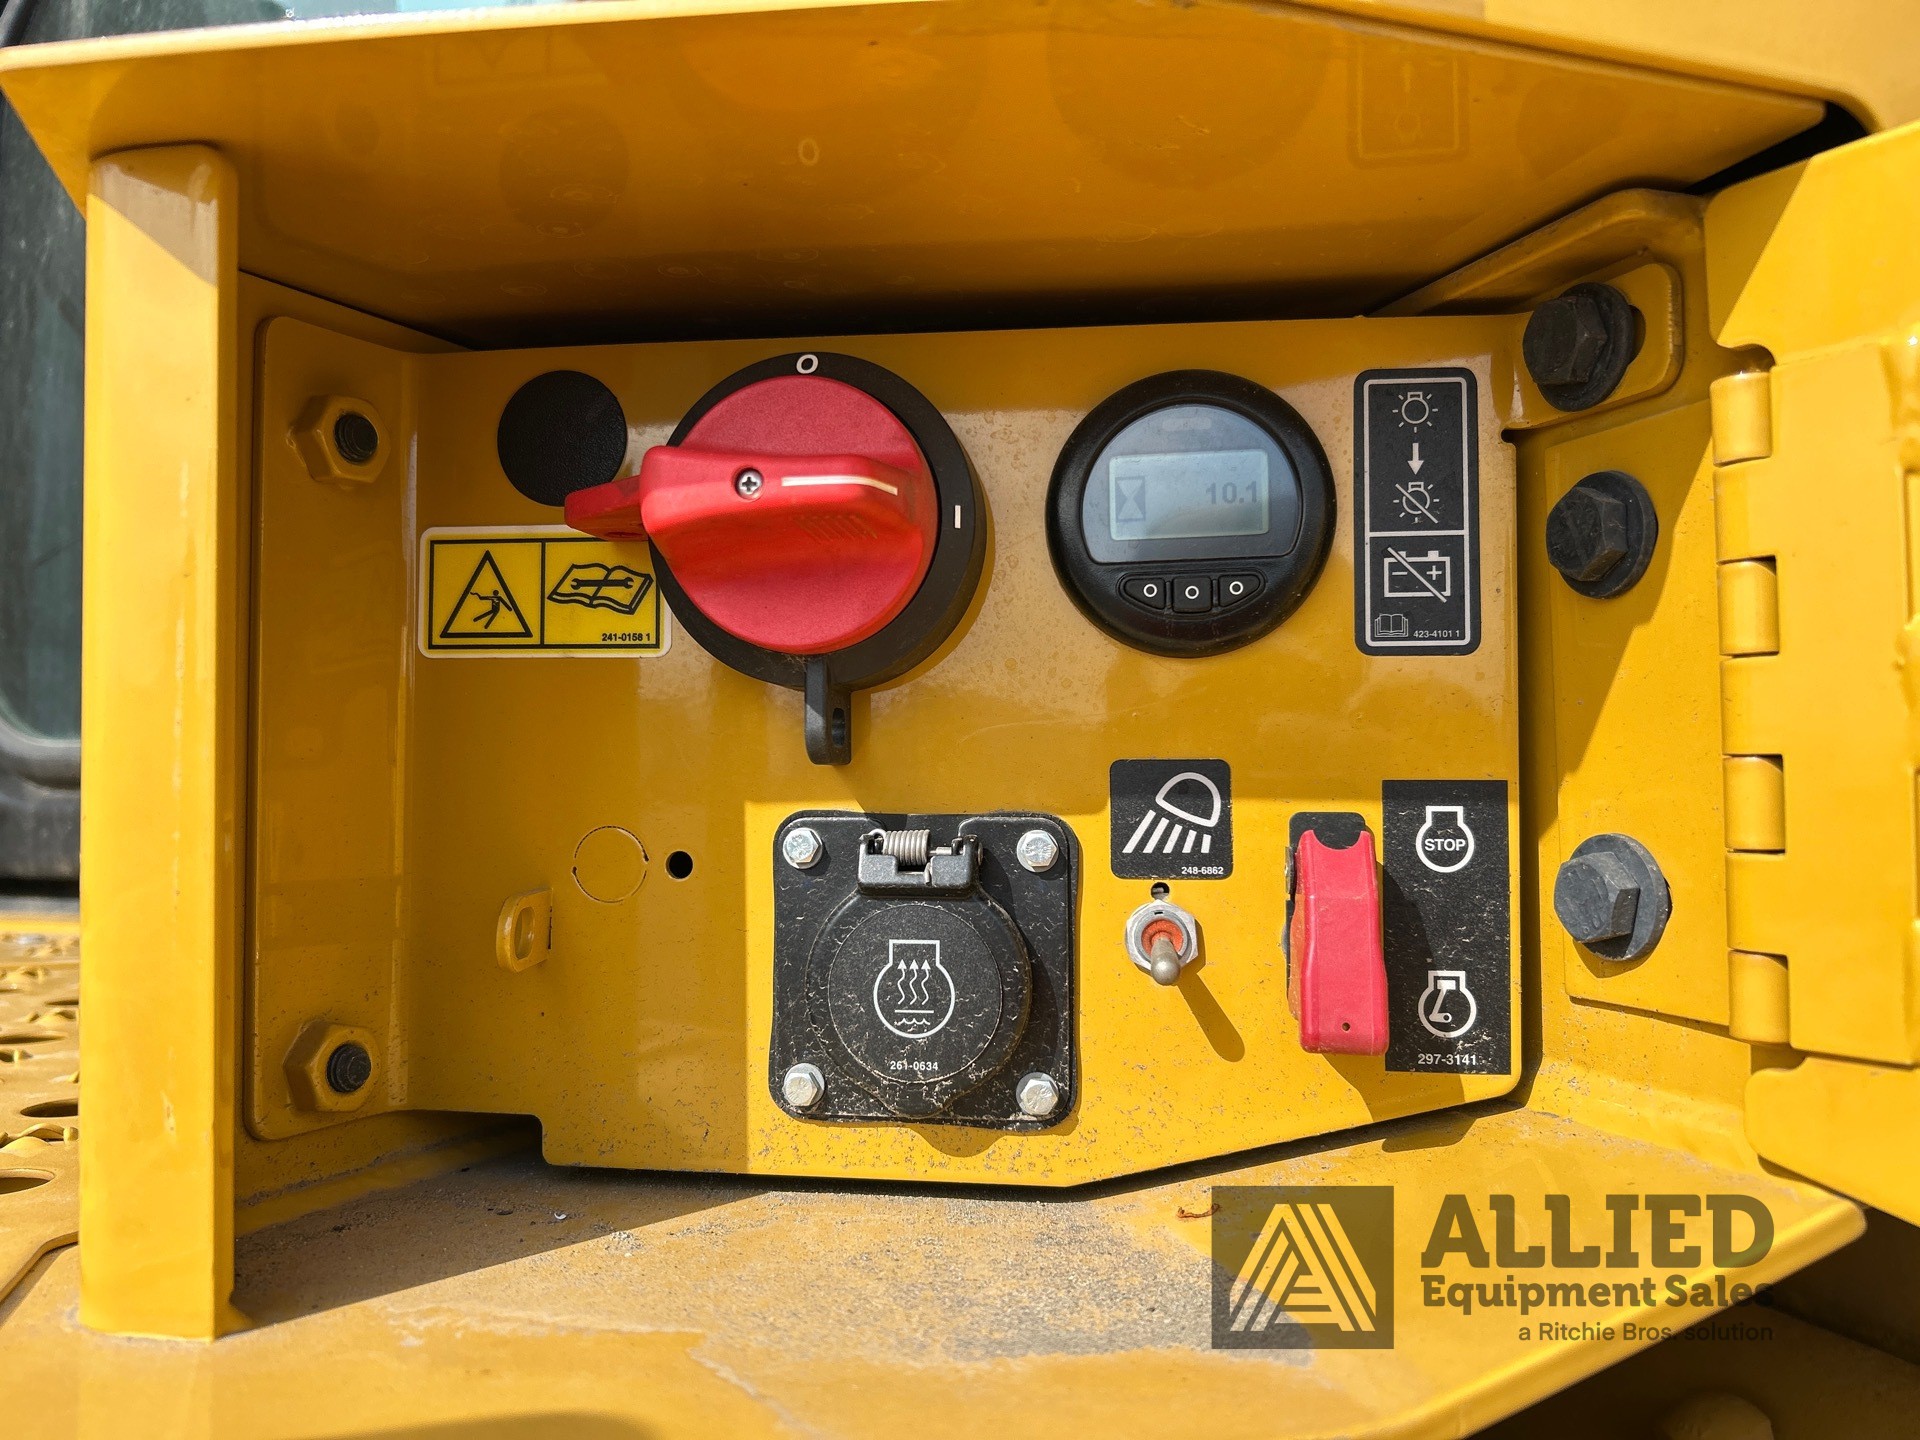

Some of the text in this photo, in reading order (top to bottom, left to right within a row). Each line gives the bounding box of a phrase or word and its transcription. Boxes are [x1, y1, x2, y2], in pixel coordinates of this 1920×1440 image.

[1205, 480, 1258, 505] 10.1
[1413, 630, 1453, 639] 423-4101
[1424, 838, 1466, 852] STOP
[1181, 866, 1224, 875] 248-6862
[890, 1060, 939, 1071] 261-0634
[1417, 1053, 1477, 1066] 297-3141
